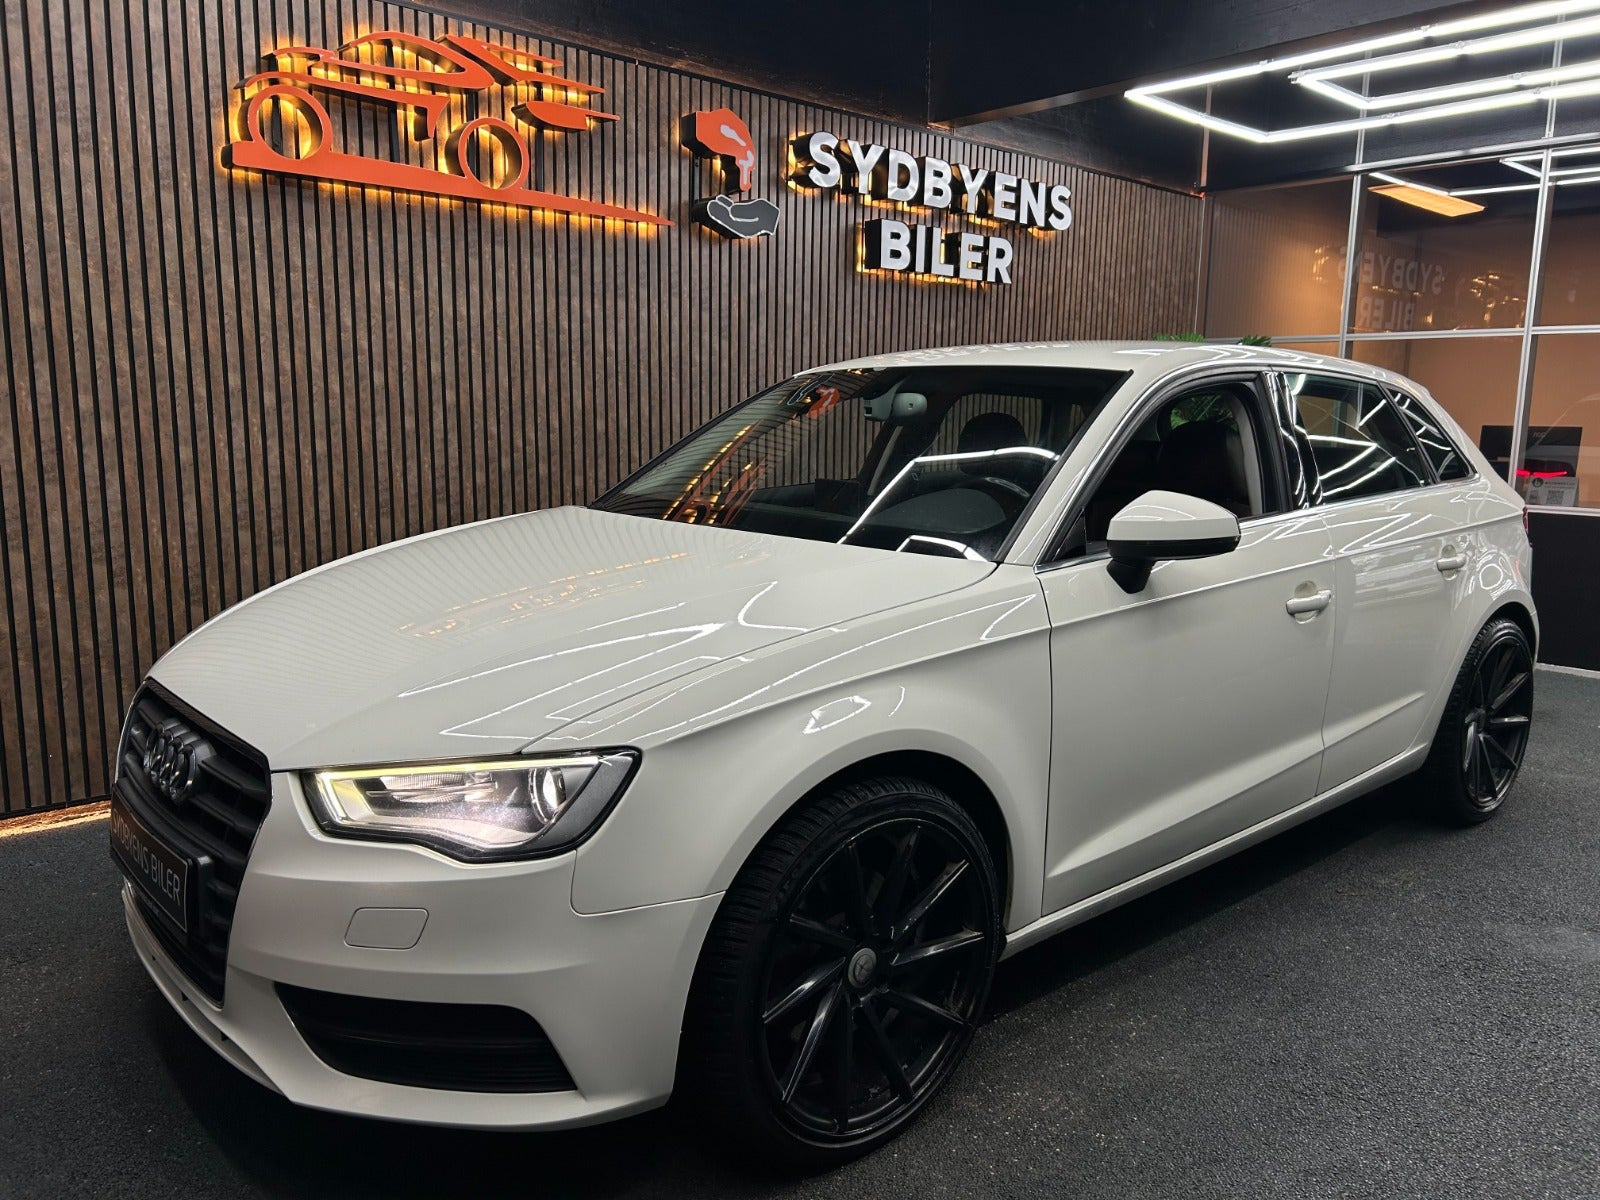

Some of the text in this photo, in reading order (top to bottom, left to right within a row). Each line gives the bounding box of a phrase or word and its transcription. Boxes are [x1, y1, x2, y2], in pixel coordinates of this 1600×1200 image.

[808, 131, 1072, 231] SYDBYENS
[881, 218, 1013, 284] BILER
[112, 807, 181, 906] SYDBYENS BILER
